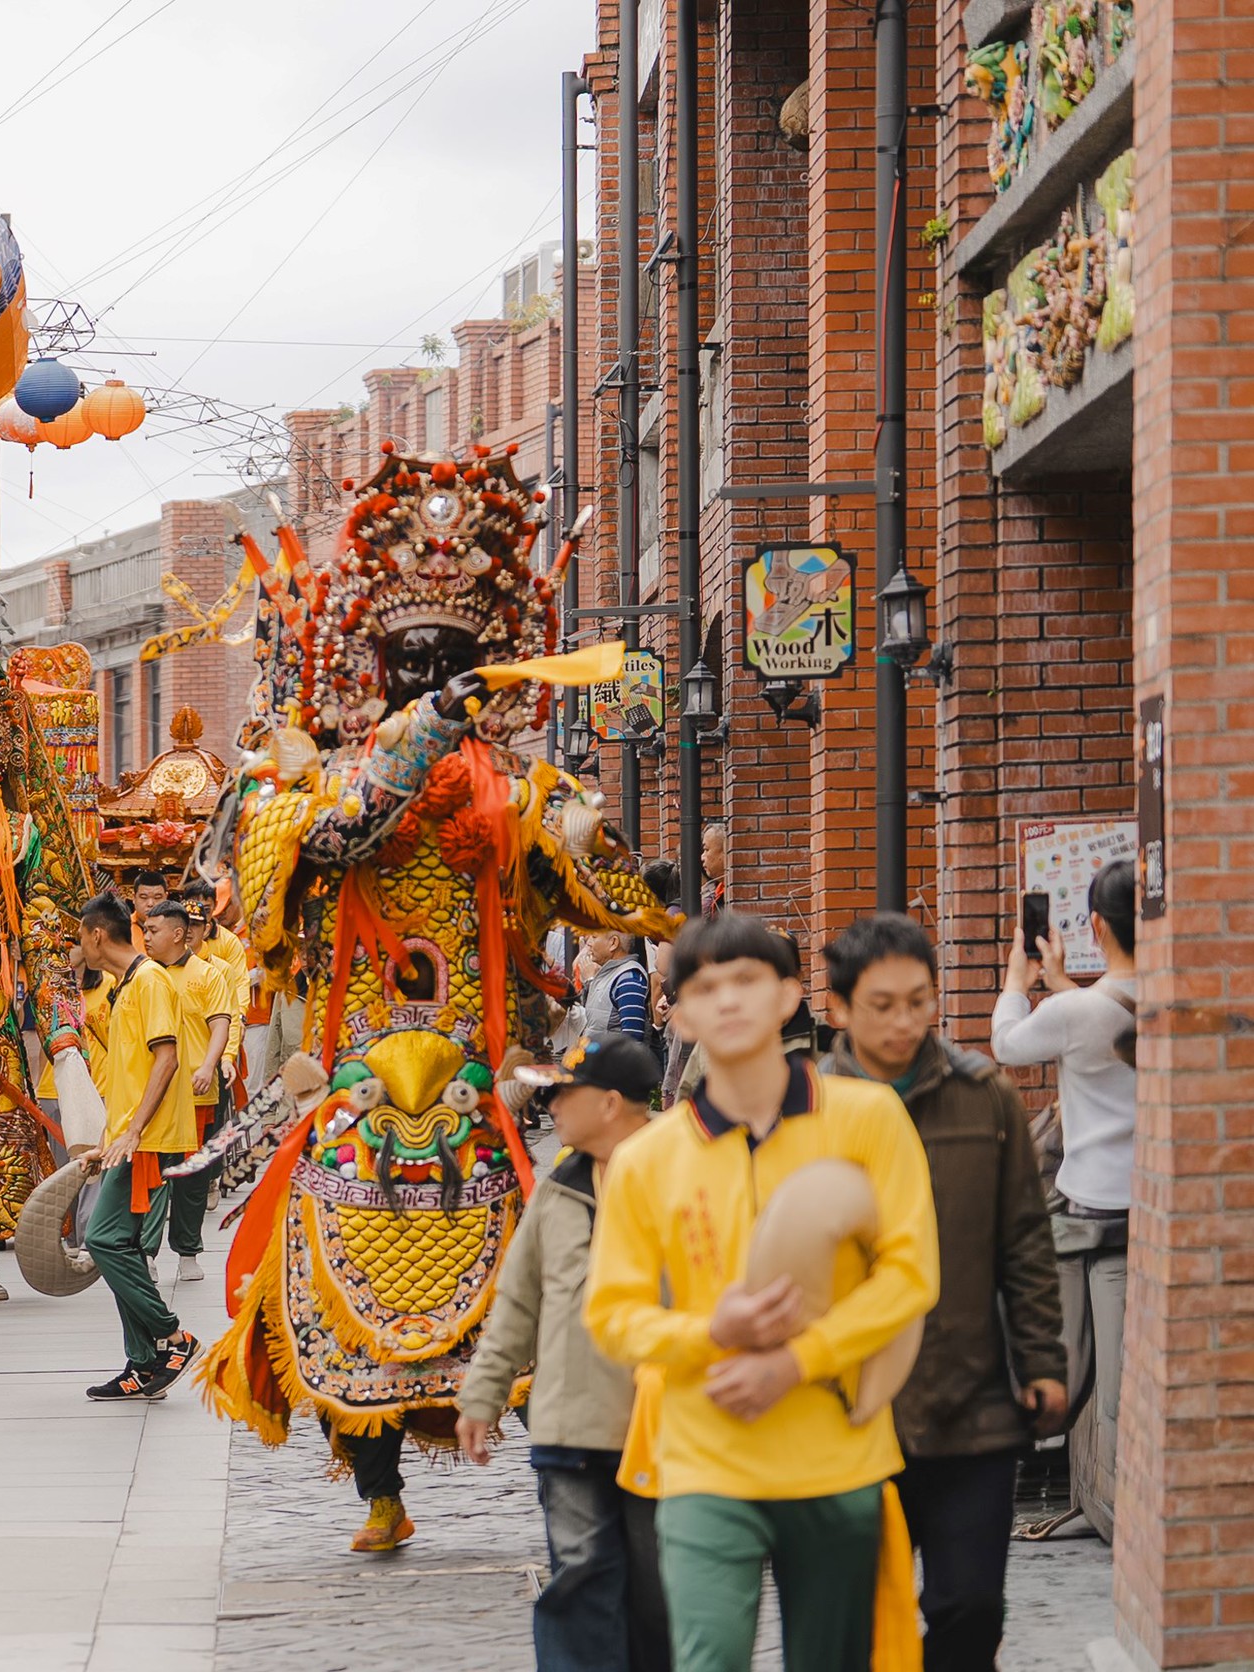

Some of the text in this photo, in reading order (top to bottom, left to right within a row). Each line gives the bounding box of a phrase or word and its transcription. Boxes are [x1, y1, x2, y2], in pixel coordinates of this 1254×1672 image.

[810, 608, 847, 646] 木
[752, 638, 815, 657] Wood
[625, 660, 656, 672] tiles
[764, 655, 832, 670] Working
